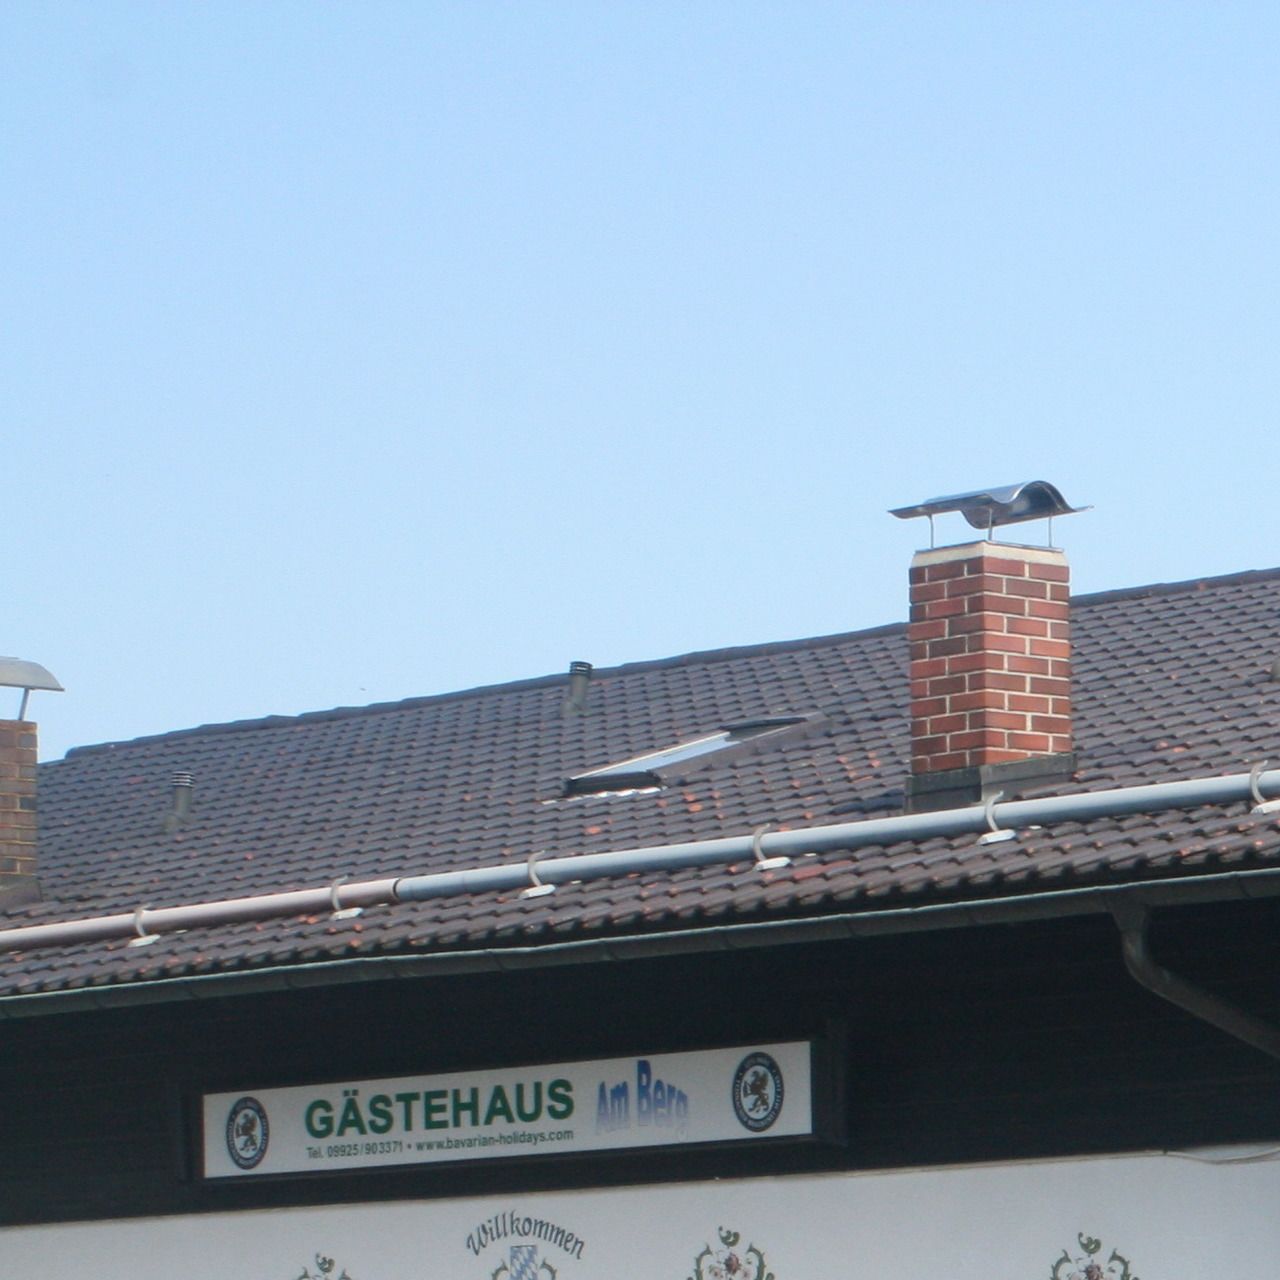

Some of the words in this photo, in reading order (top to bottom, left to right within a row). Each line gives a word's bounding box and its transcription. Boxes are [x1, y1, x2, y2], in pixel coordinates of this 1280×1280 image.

[304, 1079, 574, 1139] GÄSTEHAUS
[596, 1080, 630, 1133] Am
[637, 1060, 688, 1136] Berg
[306, 1147, 325, 1160] Tel.
[327, 1141, 402, 1158] 09925/903371
[416, 1130, 574, 1151] www.bavarian-holidays.com
[467, 1211, 584, 1259] Willkommen
